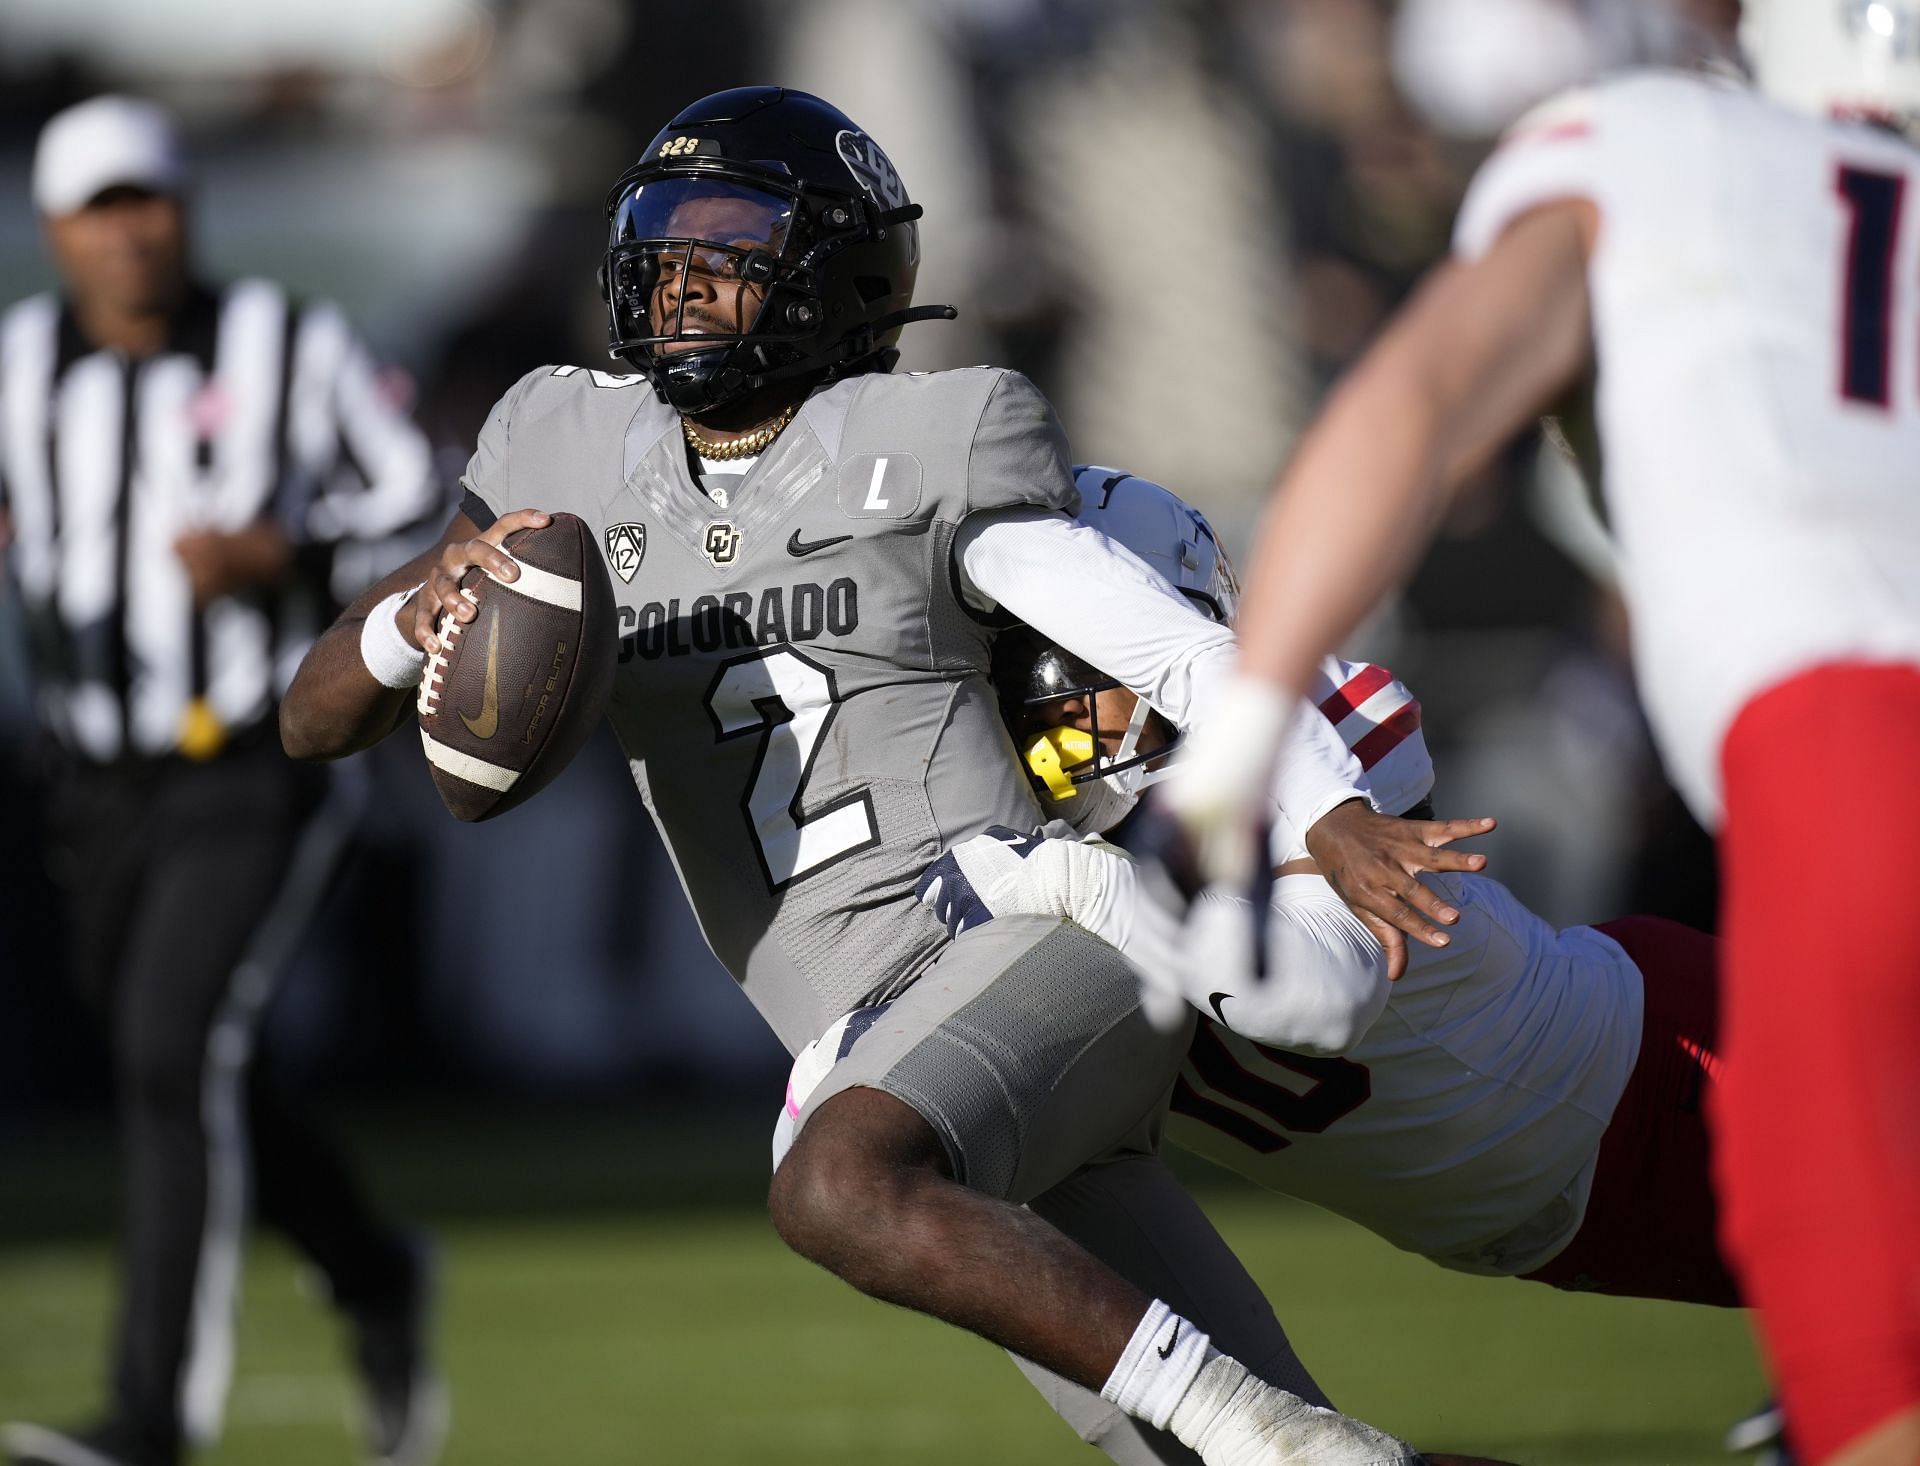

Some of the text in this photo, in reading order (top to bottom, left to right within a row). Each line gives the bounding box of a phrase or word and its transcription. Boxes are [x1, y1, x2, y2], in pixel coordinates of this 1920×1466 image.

[1834, 160, 1920, 412] 1
[863, 458, 890, 510] L
[607, 525, 643, 560] PAC
[616, 549, 635, 571] 12
[706, 524, 740, 563] CU
[618, 577, 859, 664] COLORADO
[546, 641, 567, 692] ELITE
[702, 641, 881, 897] 2
